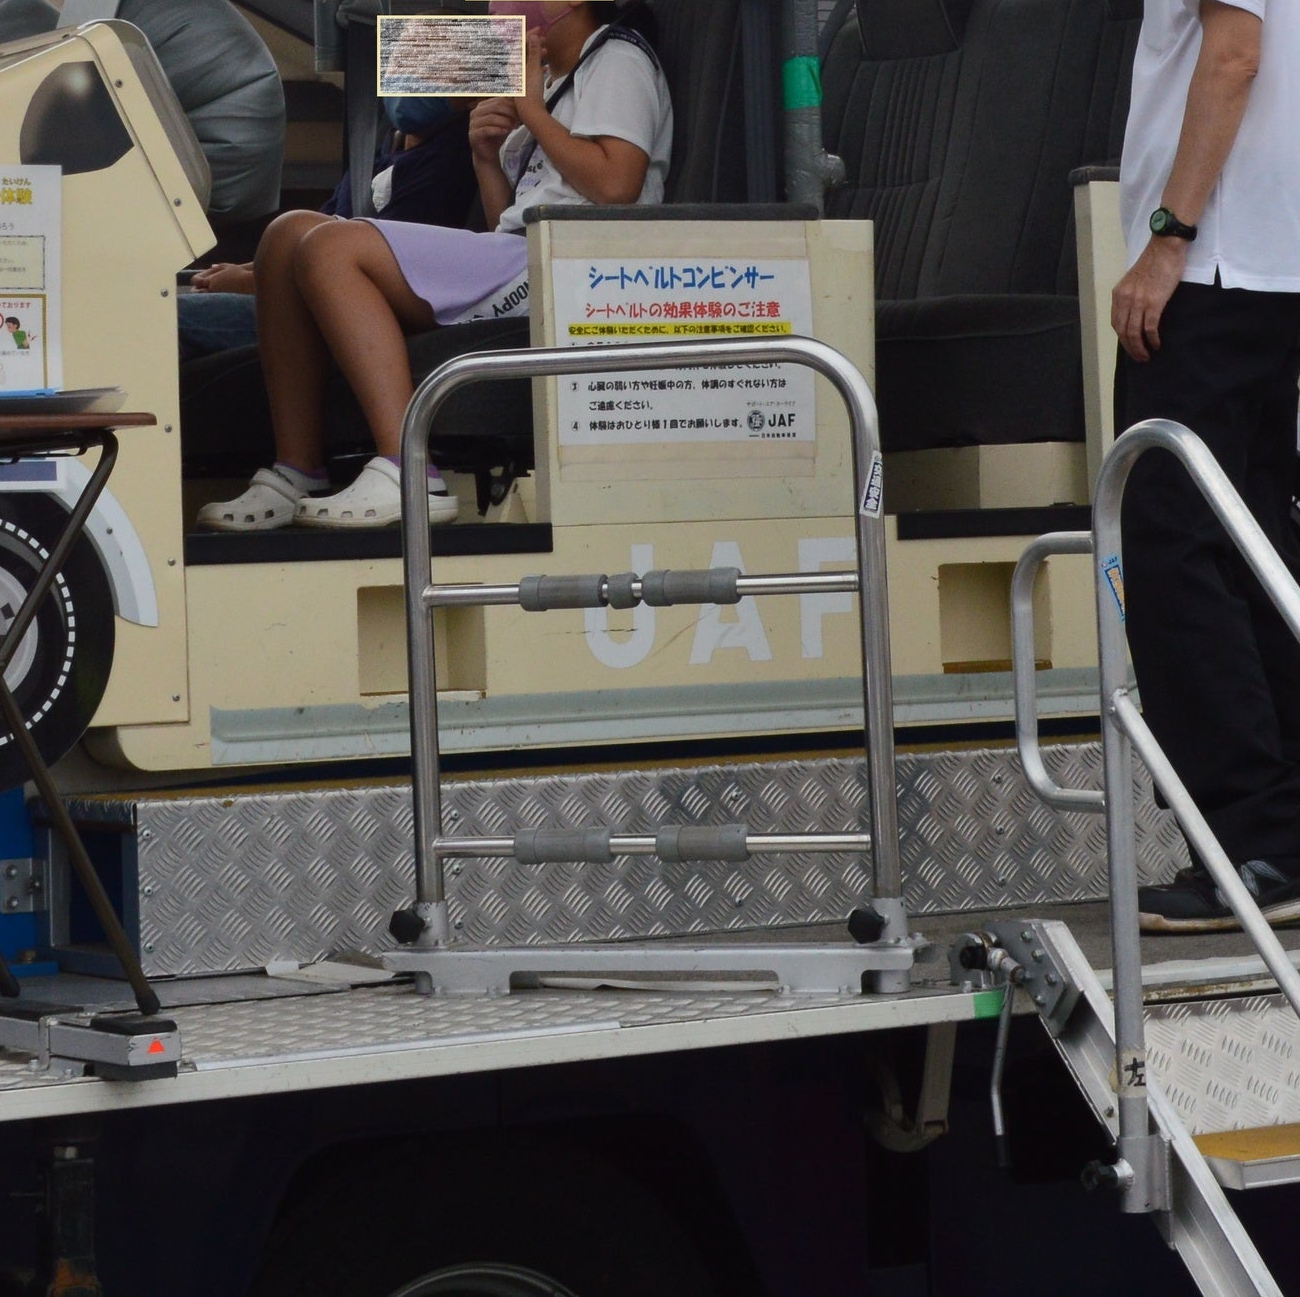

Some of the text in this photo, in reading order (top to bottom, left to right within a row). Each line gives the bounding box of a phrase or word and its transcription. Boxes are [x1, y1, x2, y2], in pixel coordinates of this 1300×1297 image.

[2, 177, 32, 186] たいけん
[588, 265, 775, 290] シートベルトコンビンサー
[492, 280, 530, 318] OOPY
[585, 301, 782, 320] シートベルトの効果体験のご注意
[588, 400, 654, 412] ご遠慮ください。
[767, 413, 797, 428] JAF
[583, 536, 858, 669] JAF
[1124, 1057, 1147, 1088] 左
